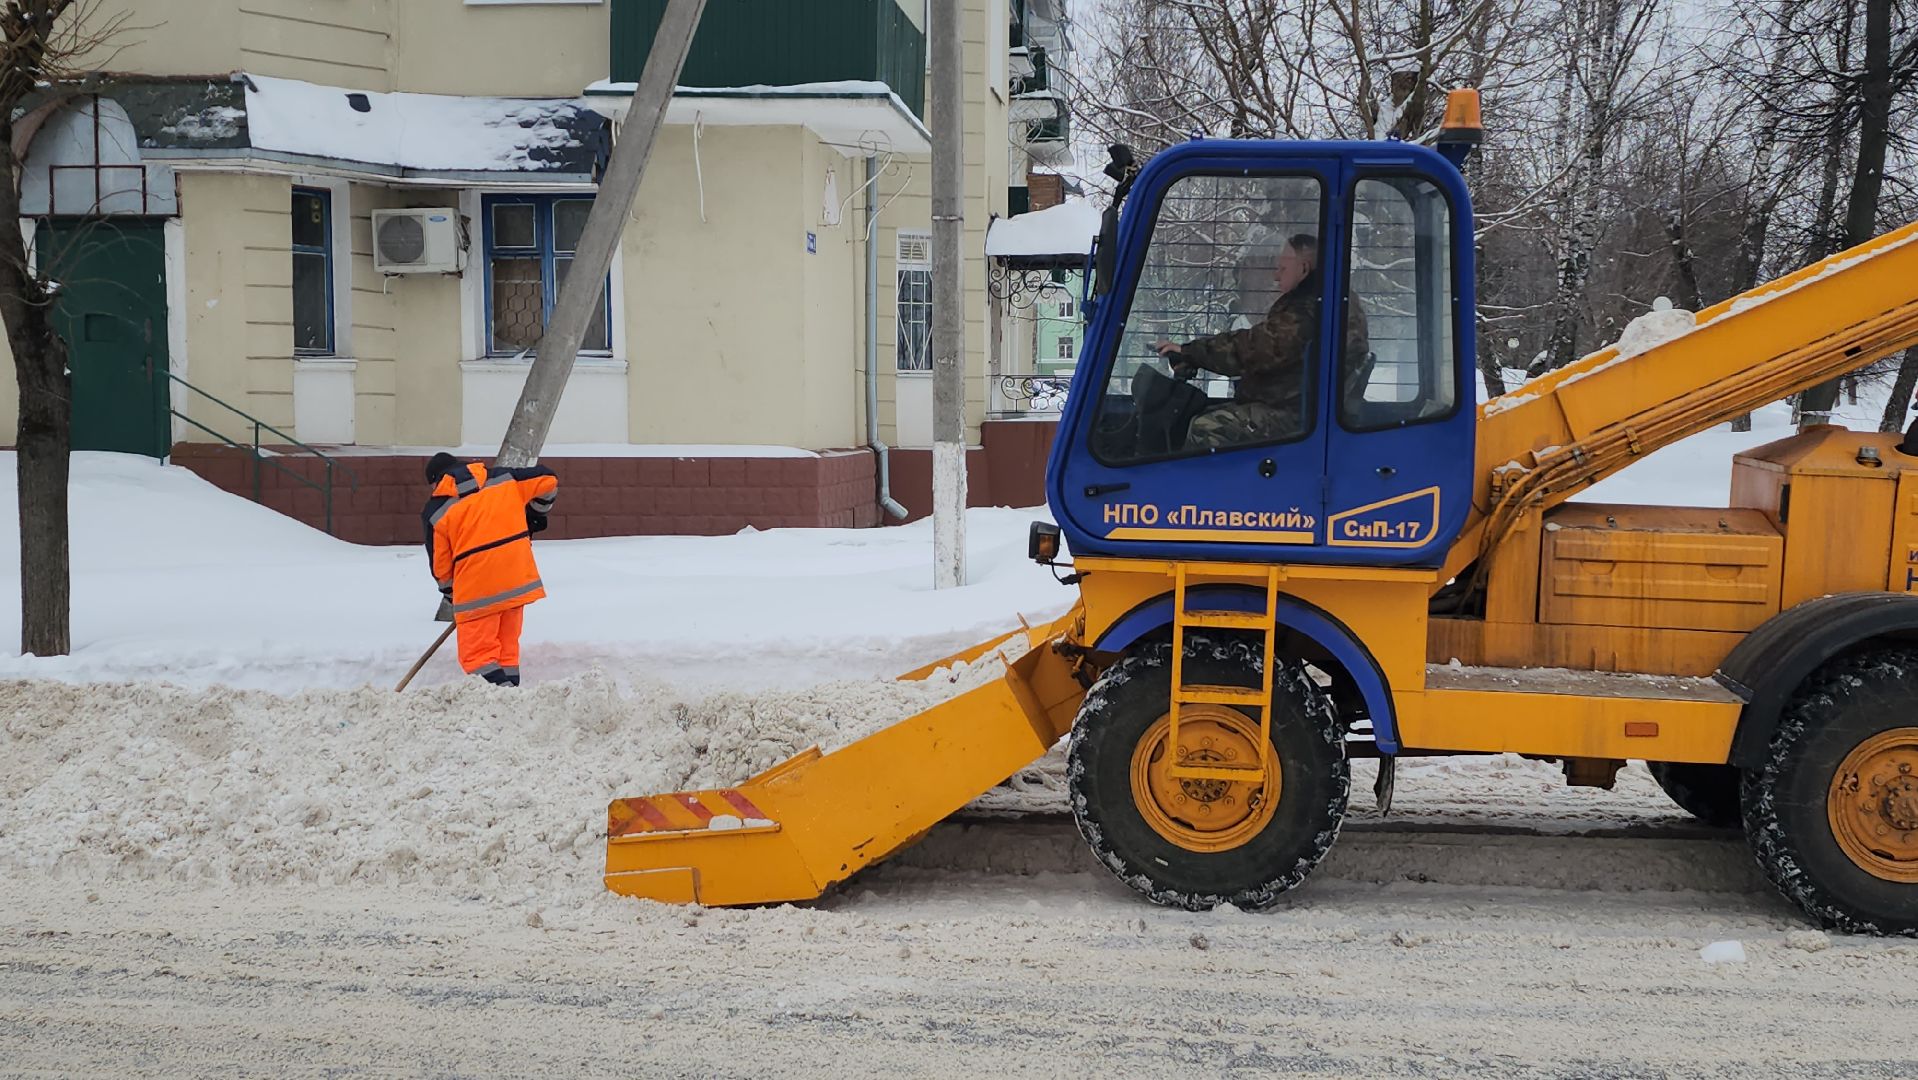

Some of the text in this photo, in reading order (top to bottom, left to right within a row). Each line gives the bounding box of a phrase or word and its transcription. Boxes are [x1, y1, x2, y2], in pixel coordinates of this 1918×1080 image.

[1103, 503, 1317, 529] НПО «Плавский»
[1344, 519, 1421, 539] СнП-17
